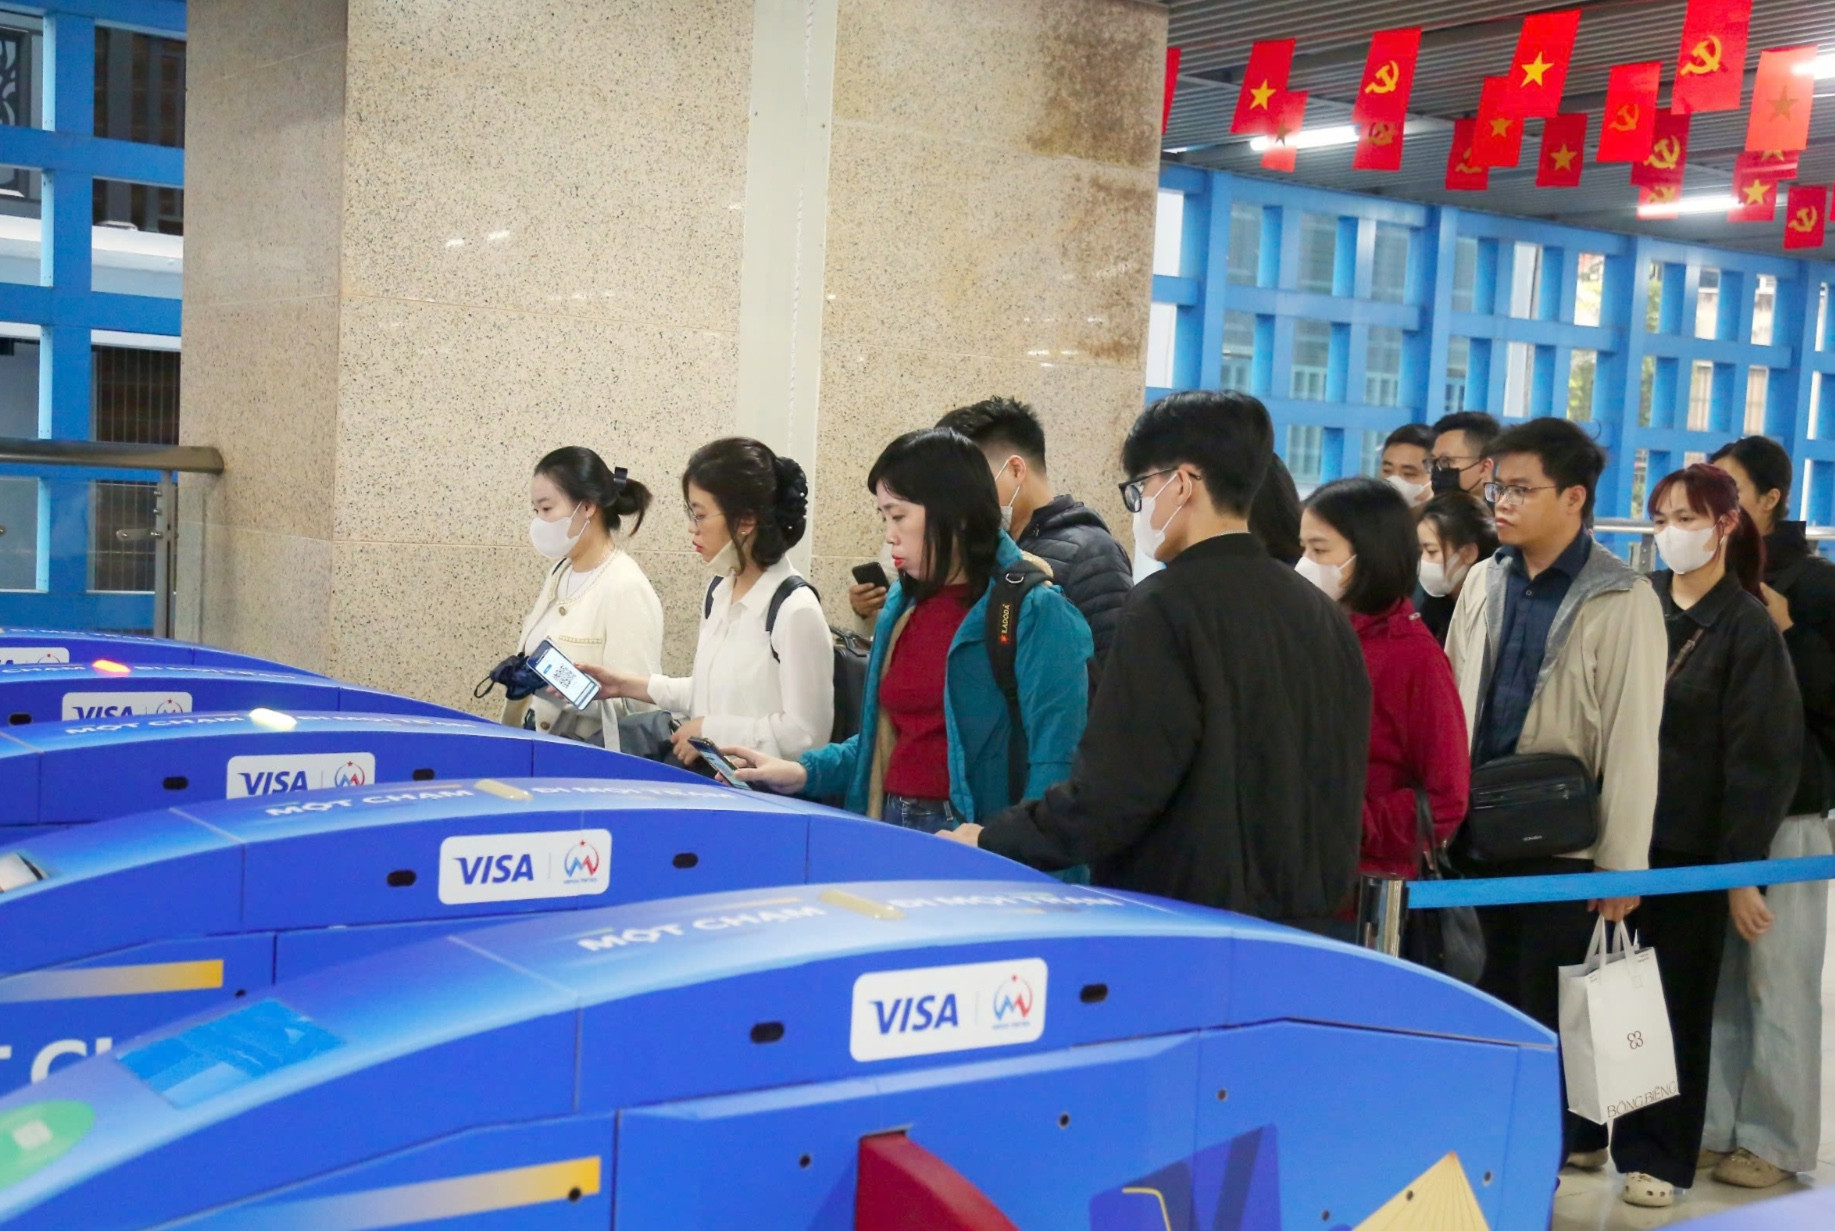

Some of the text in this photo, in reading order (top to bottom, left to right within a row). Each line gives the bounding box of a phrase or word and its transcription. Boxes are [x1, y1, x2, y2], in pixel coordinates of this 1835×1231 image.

[72, 706, 133, 719] VISA
[237, 770, 309, 796] VISA
[453, 854, 534, 885] VISA
[869, 993, 959, 1035] VISA
